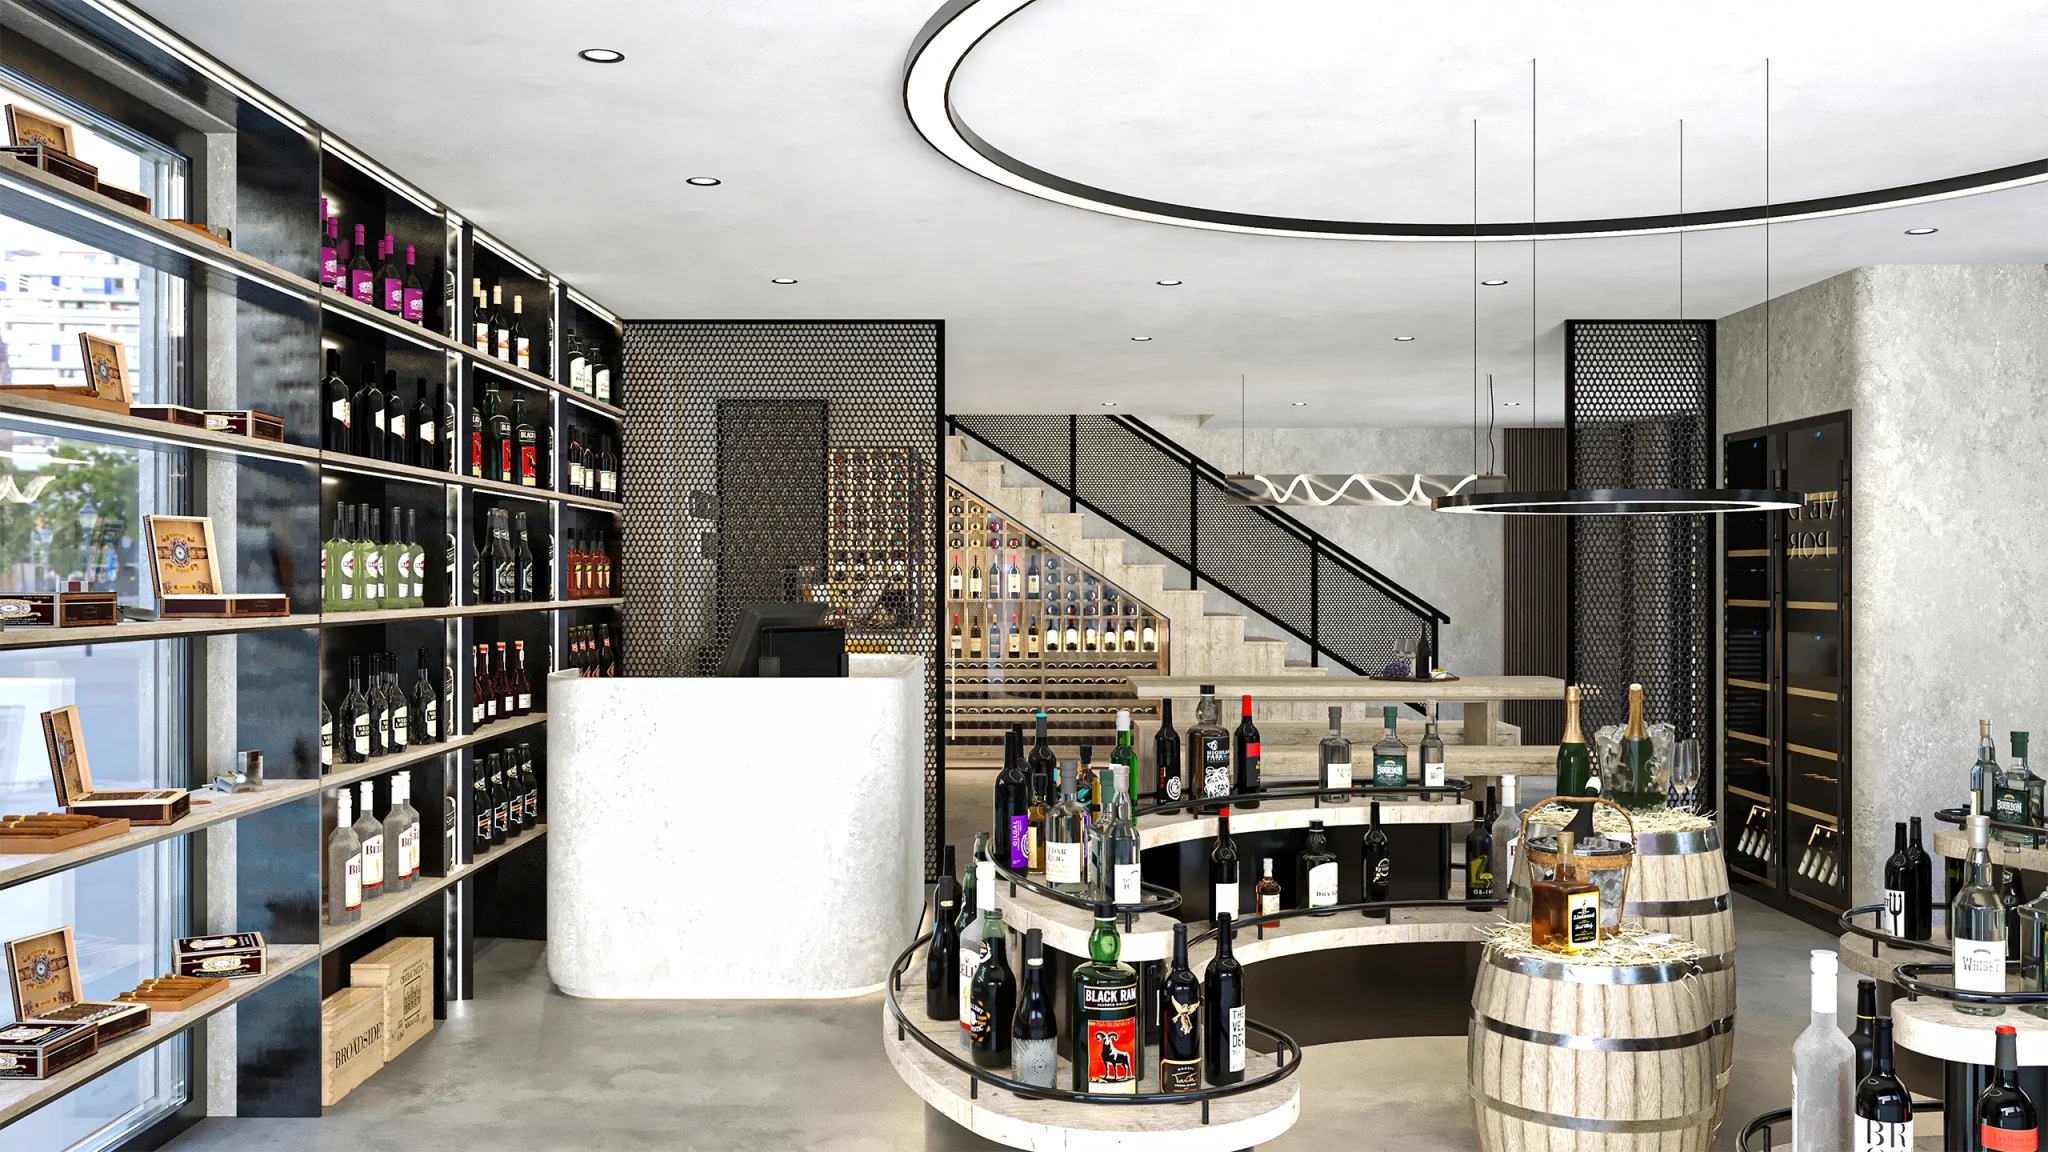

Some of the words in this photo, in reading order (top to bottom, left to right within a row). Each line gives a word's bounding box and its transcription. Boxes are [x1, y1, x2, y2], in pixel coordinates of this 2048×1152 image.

[1377, 765, 1403, 776] BOURBON
[1996, 799, 2023, 814] BOURBON
[1085, 989, 1118, 1003] BLACK
[334, 1021, 383, 1069] BROADSIDE
